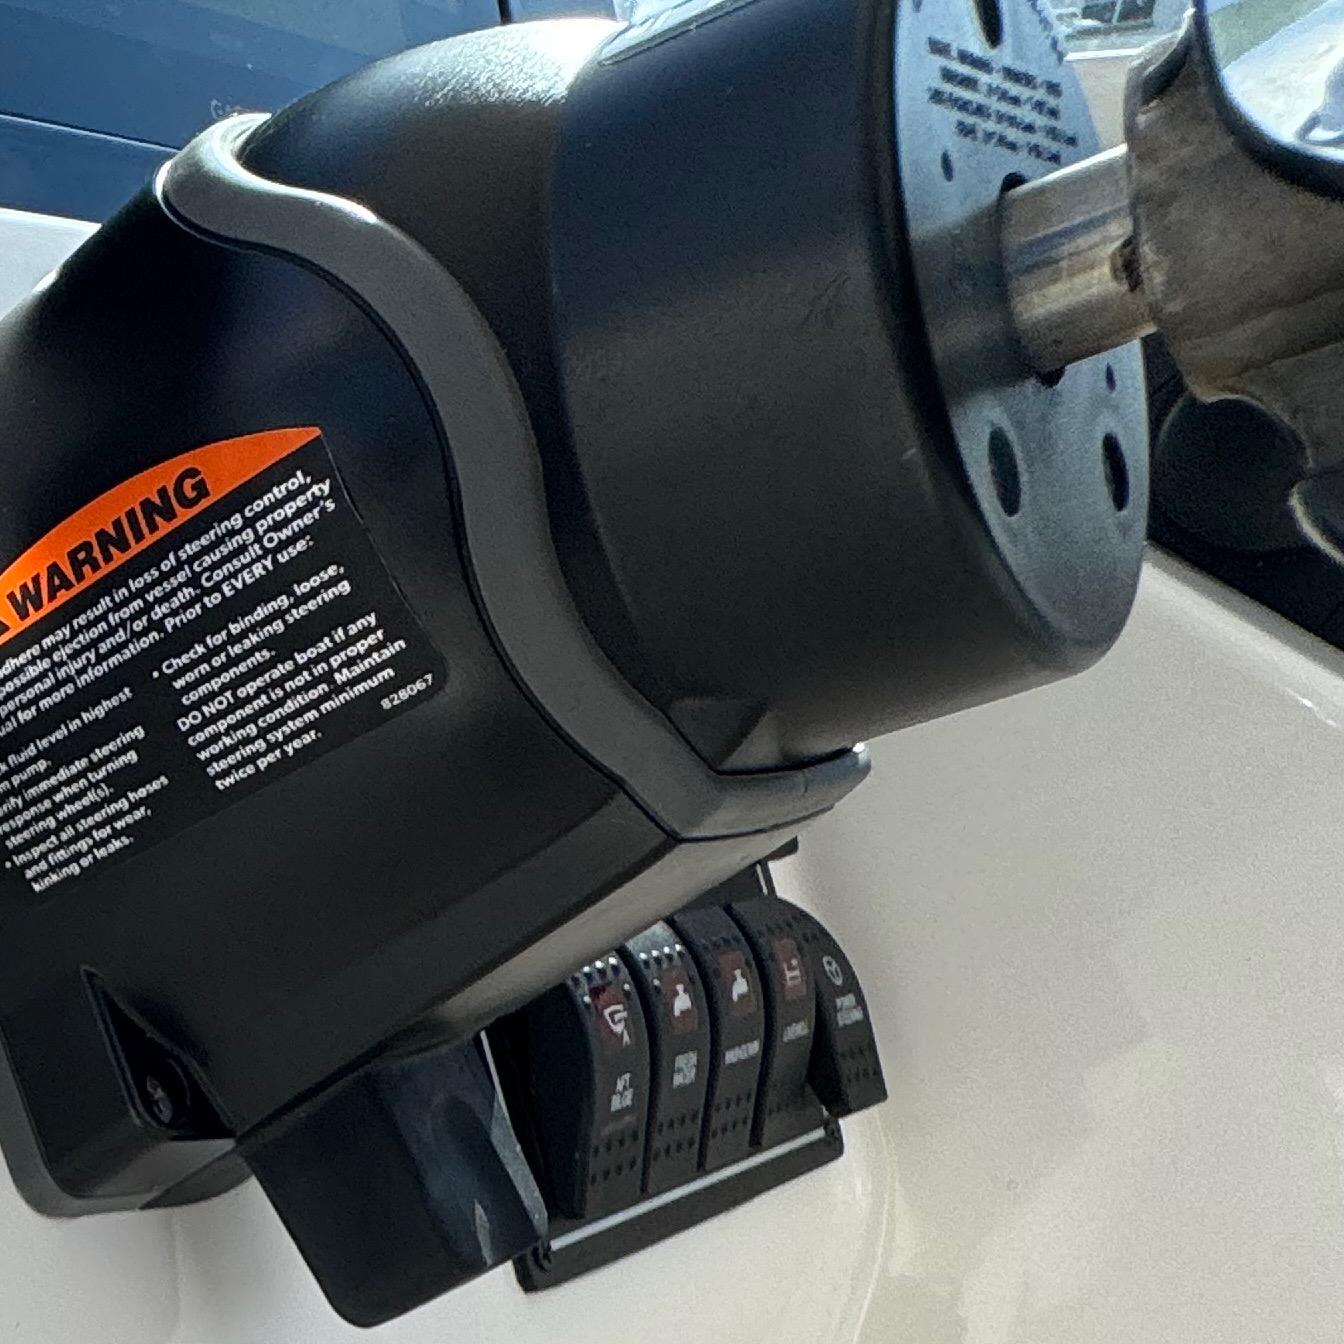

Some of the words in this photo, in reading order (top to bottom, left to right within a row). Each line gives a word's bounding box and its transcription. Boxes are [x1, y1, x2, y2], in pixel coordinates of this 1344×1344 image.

[6, 467, 211, 622] WARNING
[41, 624, 70, 650] may
[72, 596, 113, 630] result
[113, 587, 129, 603] in
[128, 567, 159, 592] loss
[160, 551, 176, 572] of
[178, 513, 243, 560] steering
[244, 470, 311, 517] control,
[52, 621, 108, 662] ejection
[108, 598, 144, 626] from
[145, 564, 192, 602] vessel
[193, 528, 255, 572] causing
[255, 478, 330, 536] property
[55, 648, 96, 680] injury
[98, 615, 148, 654] and/or
[150, 587, 200, 620] death.
[201, 543, 263, 587] Consult
[263, 498, 335, 548] Owner's
[17, 705, 37, 724] for
[38, 683, 75, 711] more
[74, 631, 164, 688] information.
[164, 602, 202, 633] Prior
[203, 592, 222, 608] to
[221, 554, 274, 597] EVERY
[276, 535, 314, 563] use:
[162, 643, 207, 674] Check
[206, 629, 227, 648] for
[228, 594, 294, 635] binding,
[293, 565, 344, 596] loose,
[172, 663, 211, 689] worn
[211, 651, 226, 667] or
[227, 619, 285, 657] leaking
[285, 580, 351, 624] steering
[177, 711, 202, 731] DO
[201, 690, 234, 718] NOT
[236, 660, 295, 698] operate
[294, 636, 334, 665] boat
[331, 626, 346, 643] if
[347, 612, 376, 636] any
[181, 649, 276, 705] components.
[188, 694, 270, 746] component
[268, 687, 284, 701] is
[284, 670, 313, 692] not
[310, 662, 329, 676] in
[329, 629, 384, 669] proper
[196, 723, 258, 761] working
[333, 639, 406, 685] Maintain
[206, 738, 267, 777] steering
[266, 709, 320, 743] system
[319, 668, 395, 714] minimum
[380, 673, 432, 709] 828067
[52, 778, 88, 803] when
[87, 750, 138, 783] turning
[215, 764, 256, 790] twice
[256, 748, 281, 771] per
[283, 730, 322, 757] year.
